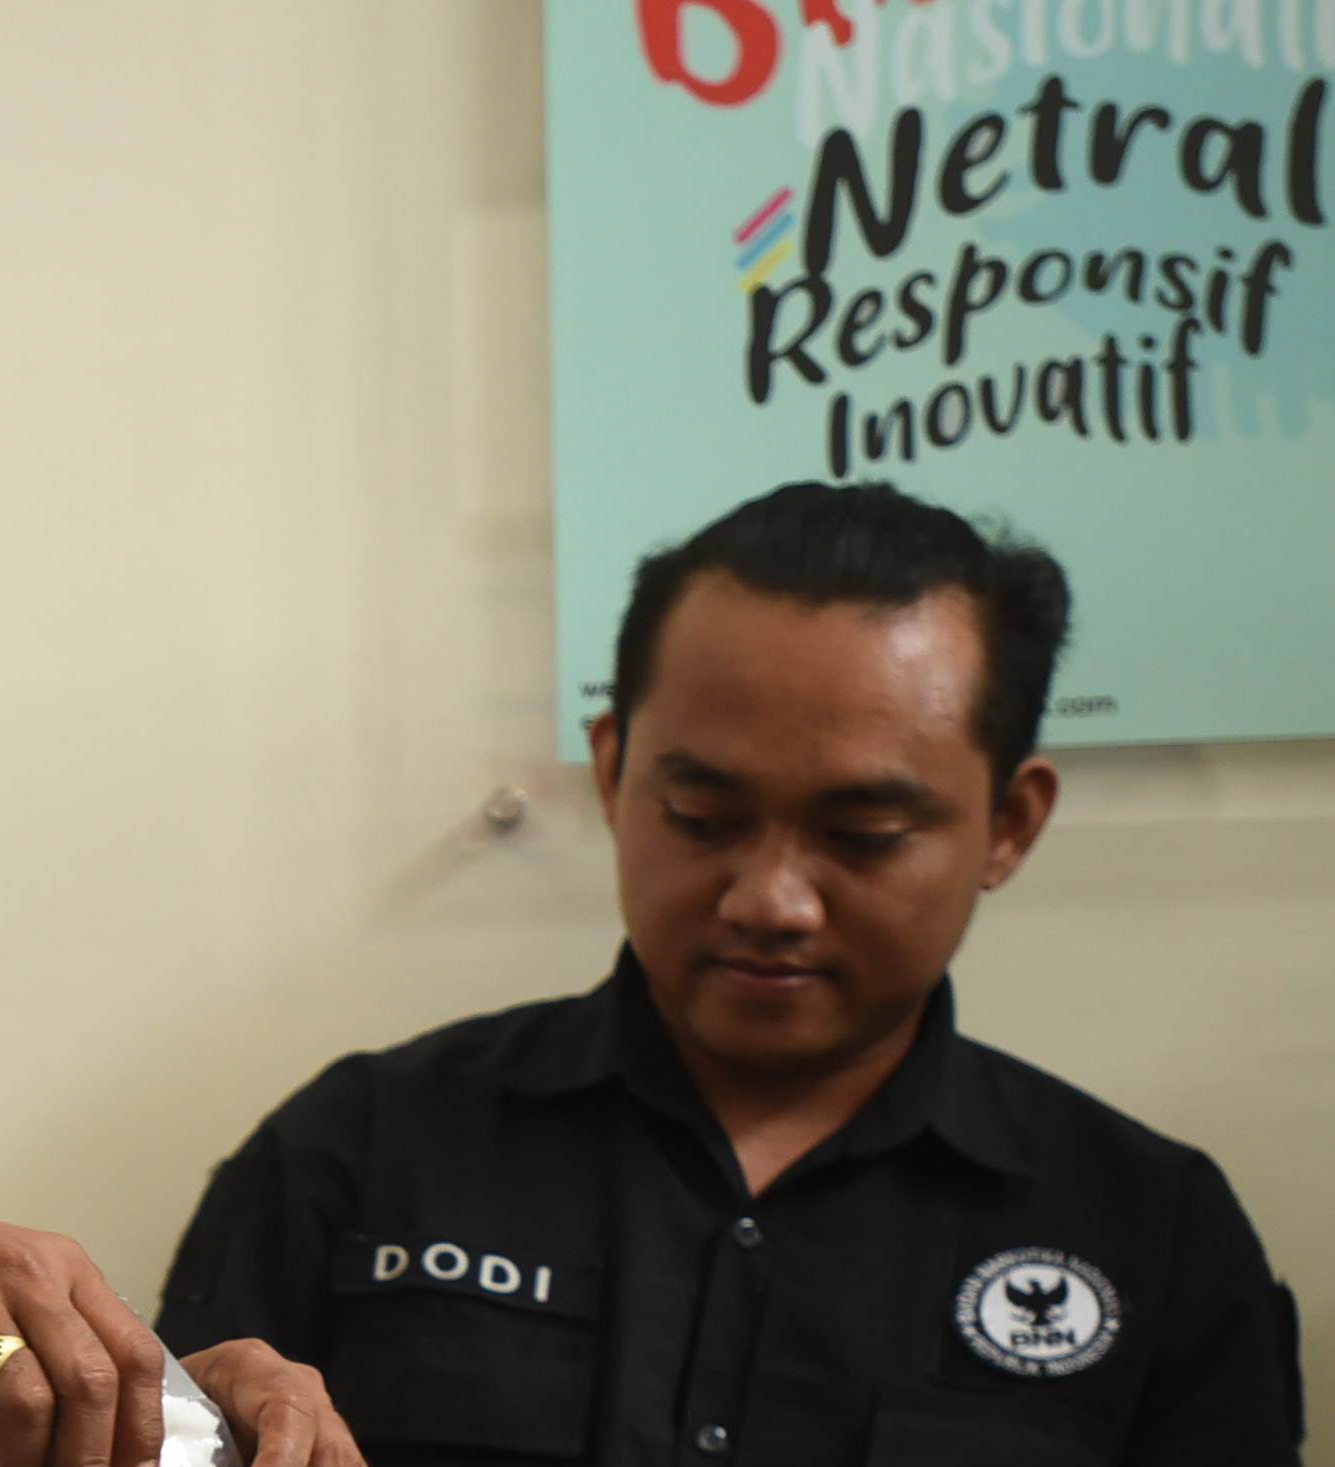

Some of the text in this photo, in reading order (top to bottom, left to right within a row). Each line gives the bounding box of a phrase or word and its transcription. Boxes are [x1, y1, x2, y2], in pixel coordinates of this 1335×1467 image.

[802, 73, 1327, 278] Netral
[747, 239, 1293, 405] Responsif
[827, 315, 1203, 479] Inovatif
[372, 1242, 552, 1303] DODI
